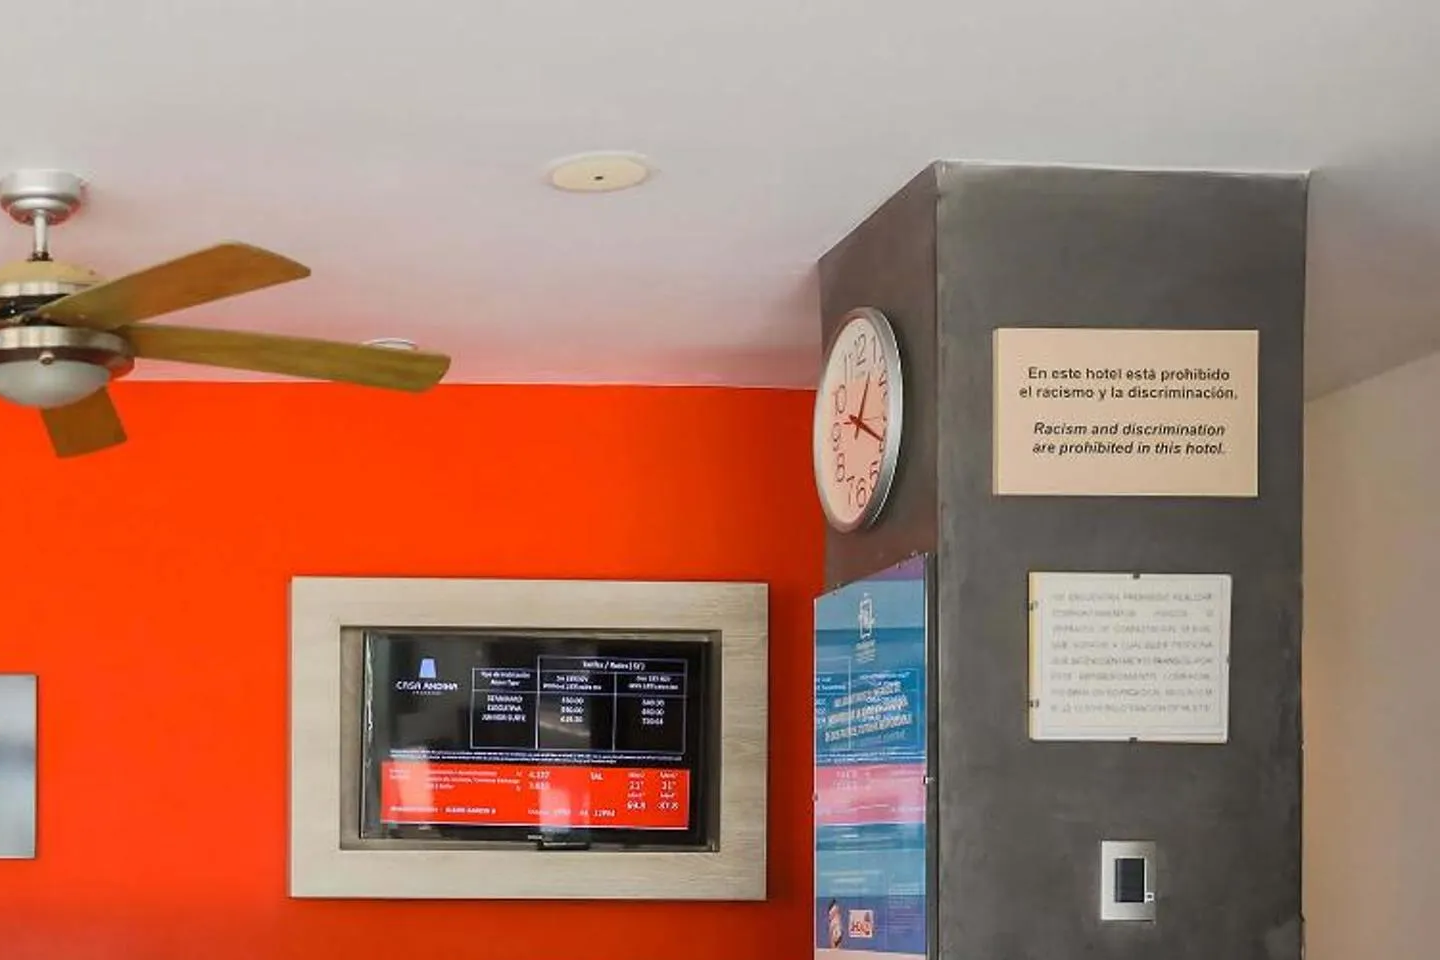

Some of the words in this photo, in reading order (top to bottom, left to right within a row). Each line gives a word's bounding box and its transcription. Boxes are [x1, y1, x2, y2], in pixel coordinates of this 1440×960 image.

[1028, 366, 1047, 379] En
[1051, 368, 1081, 379] este
[1086, 367, 1122, 379] hotel
[1126, 367, 1156, 380] está
[1160, 368, 1230, 382] prohibido
[1019, 386, 1032, 398] el
[1036, 387, 1093, 398] racismo
[1098, 389, 1107, 401] y
[1111, 386, 1123, 398] la
[1033, 422, 1087, 435] Racism
[1091, 423, 1118, 435] and
[1122, 423, 1225, 436] discrimination
[1032, 443, 1055, 453] are
[1059, 441, 1133, 455] prohibited
[1137, 441, 1150, 454] in
[1155, 441, 1181, 454] this
[835, 452, 845, 482] 8
[856, 478, 866, 508] 6
